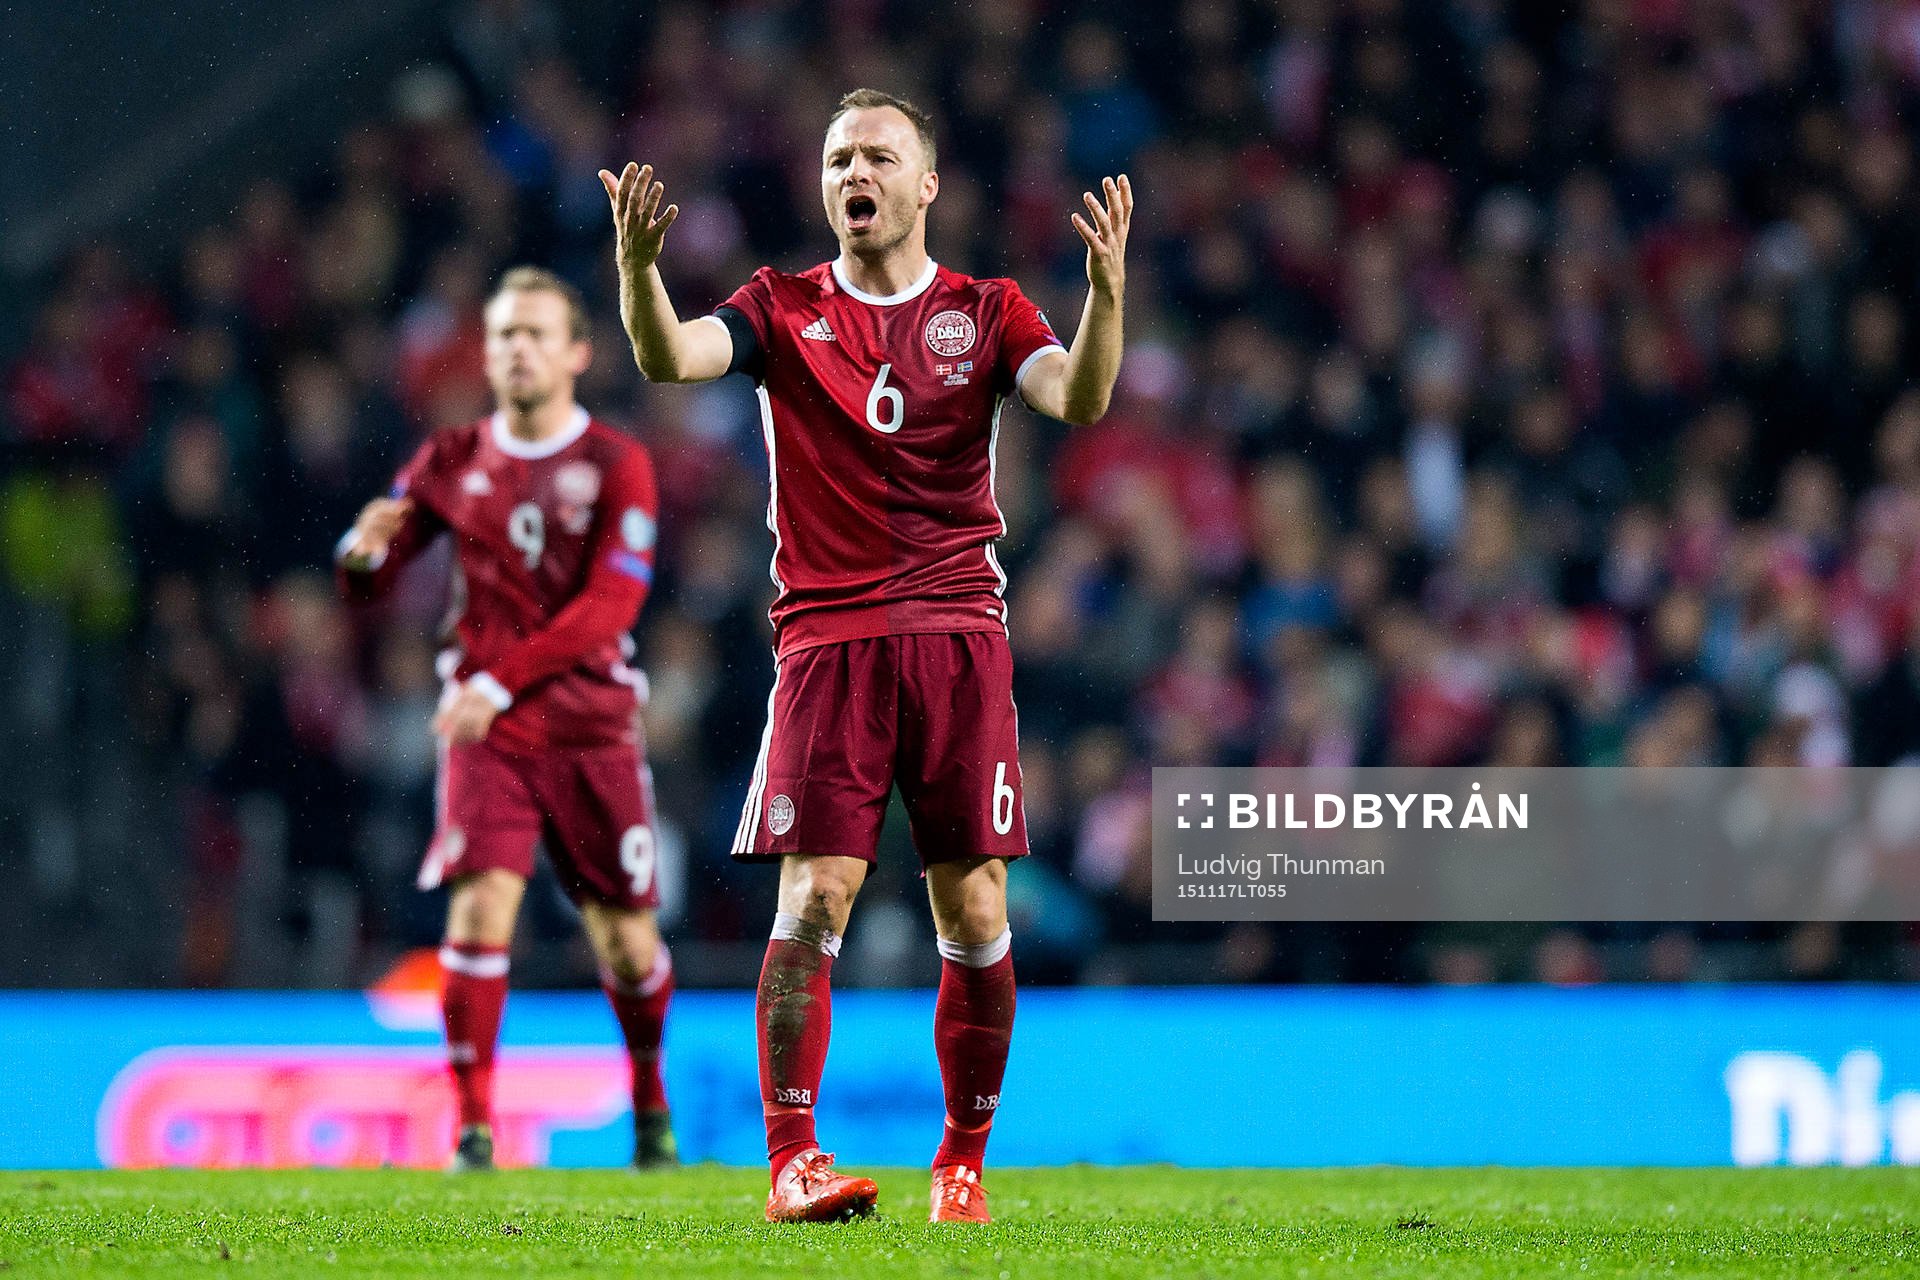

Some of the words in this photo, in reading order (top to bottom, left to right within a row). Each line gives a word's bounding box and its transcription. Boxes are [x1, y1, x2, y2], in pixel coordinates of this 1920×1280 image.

[801, 329, 837, 342] adidas
[937, 325, 964, 340] DBU
[866, 363, 904, 433] 6
[508, 502, 545, 571] 9
[992, 761, 1015, 835] 6
[620, 825, 655, 896] 9
[776, 1088, 811, 1104] DBU
[973, 1094, 1000, 1110] DB
